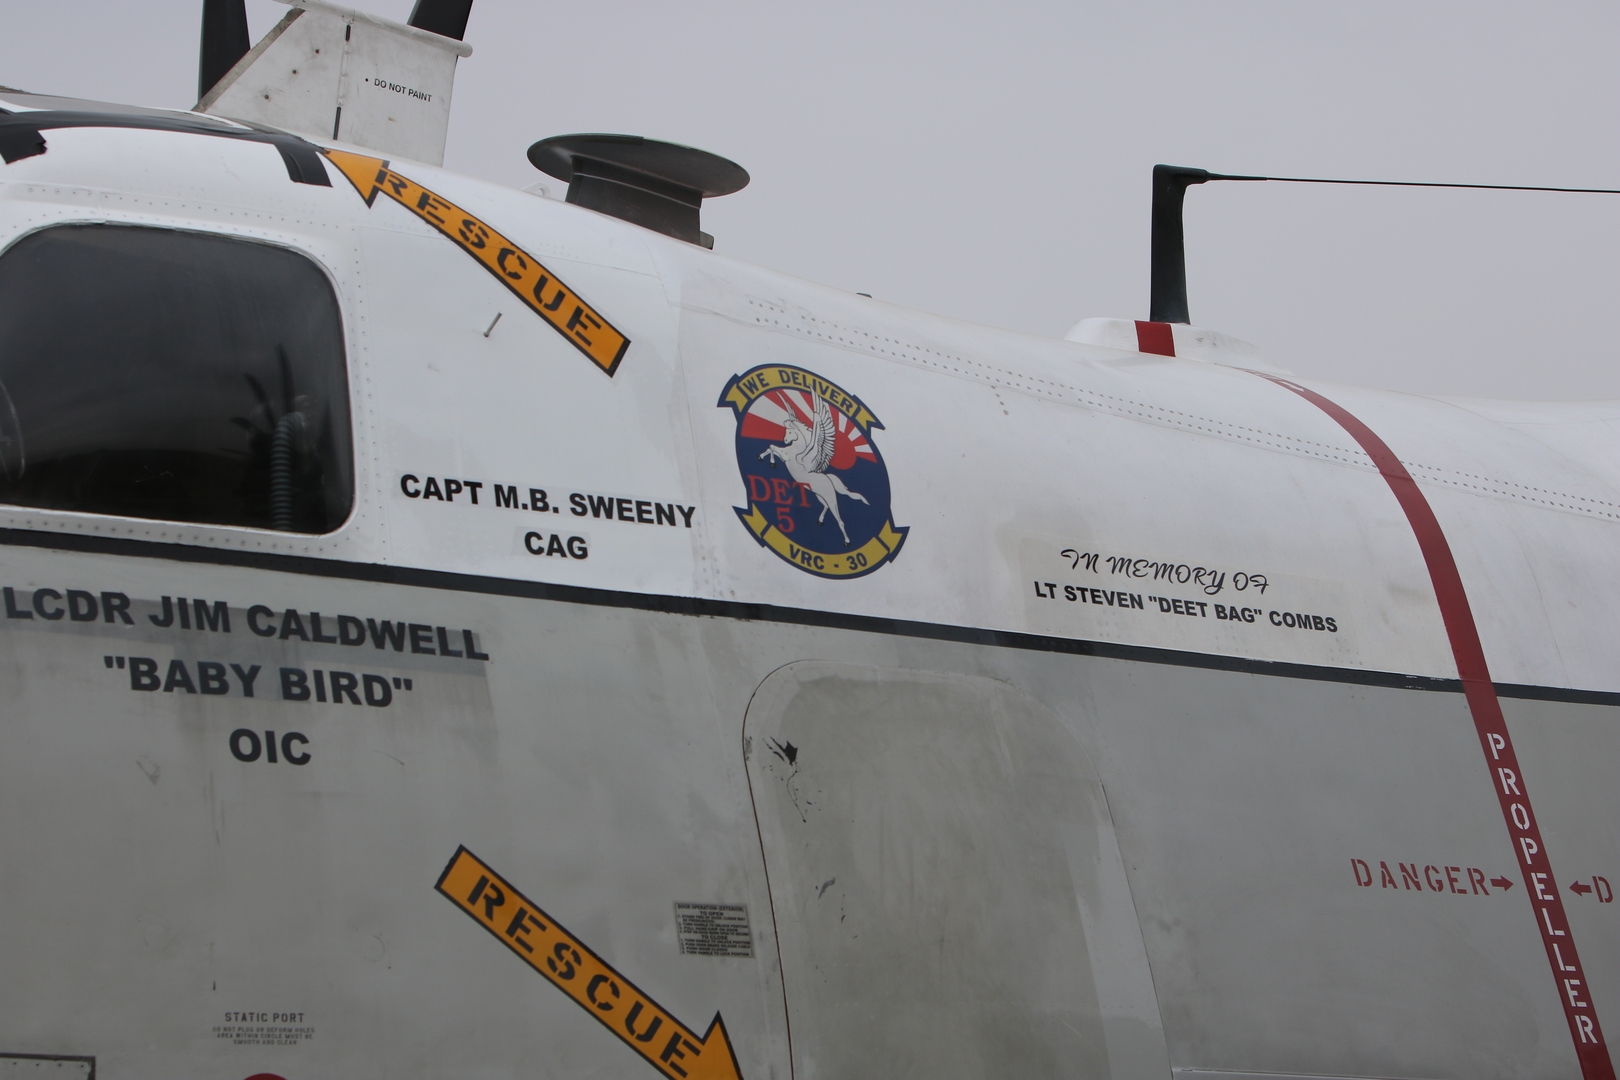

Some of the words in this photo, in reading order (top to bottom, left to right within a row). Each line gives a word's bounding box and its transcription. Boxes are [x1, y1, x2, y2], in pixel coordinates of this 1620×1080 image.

[374, 78, 386, 88] DO
[389, 83, 406, 94] NOT
[408, 89, 432, 102] PAINT
[374, 169, 602, 347] RESCUE
[743, 373, 769, 395] WE
[778, 370, 853, 413] DELIVER
[400, 474, 482, 505] CAPT
[494, 484, 560, 514] M.B.
[569, 492, 696, 528] SWEENY
[747, 475, 812, 508] DET
[776, 507, 795, 533] 5
[524, 531, 588, 560] CAG
[789, 544, 825, 570] VRC
[846, 553, 867, 570] 30
[1060, 549, 1099, 573] IN
[1106, 556, 1226, 595] MEMORY
[1233, 572, 1269, 594] OF
[2, 586, 135, 625] LCDR
[148, 595, 231, 633] JIM
[246, 604, 490, 661] CALDWELL
[1034, 581, 1057, 599] LT
[1064, 585, 1144, 610] STEVEN
[1148, 595, 1208, 618] "DEET
[1214, 603, 1262, 623] BAG"
[1269, 610, 1338, 633] COMBS
[103, 655, 262, 698] "BABY
[279, 666, 413, 708] BIRD"
[229, 728, 312, 766] OIC
[1350, 858, 1490, 896] DANGER
[1487, 733, 1598, 1044] PROPELLER
[467, 875, 701, 1078] RESCUE
[225, 1012, 268, 1022] STATIC
[273, 1013, 304, 1023] PORT
